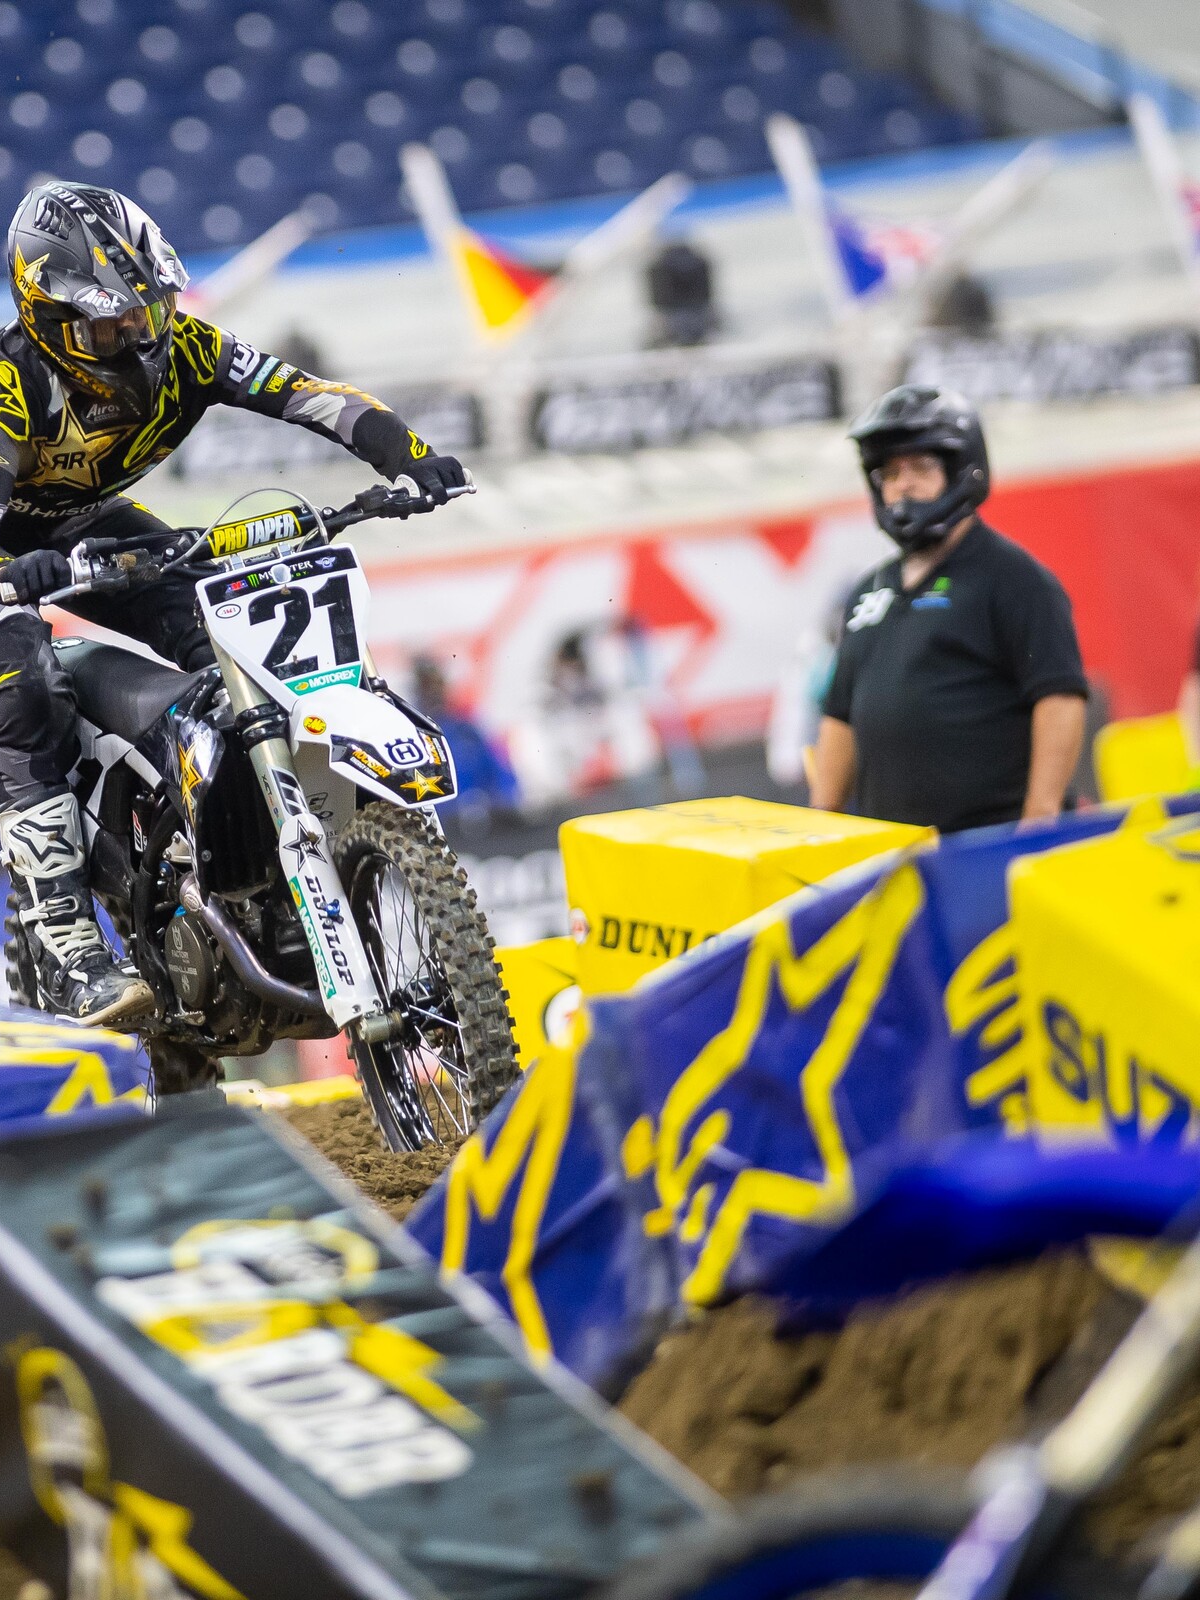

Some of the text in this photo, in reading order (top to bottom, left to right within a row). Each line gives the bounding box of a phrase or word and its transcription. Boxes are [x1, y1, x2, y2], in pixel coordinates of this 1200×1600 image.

[213, 514, 296, 553] PROTAPER
[248, 573, 360, 681] 21
[308, 668, 357, 688] MOTOREX
[299, 908, 334, 1000] MOTOREX
